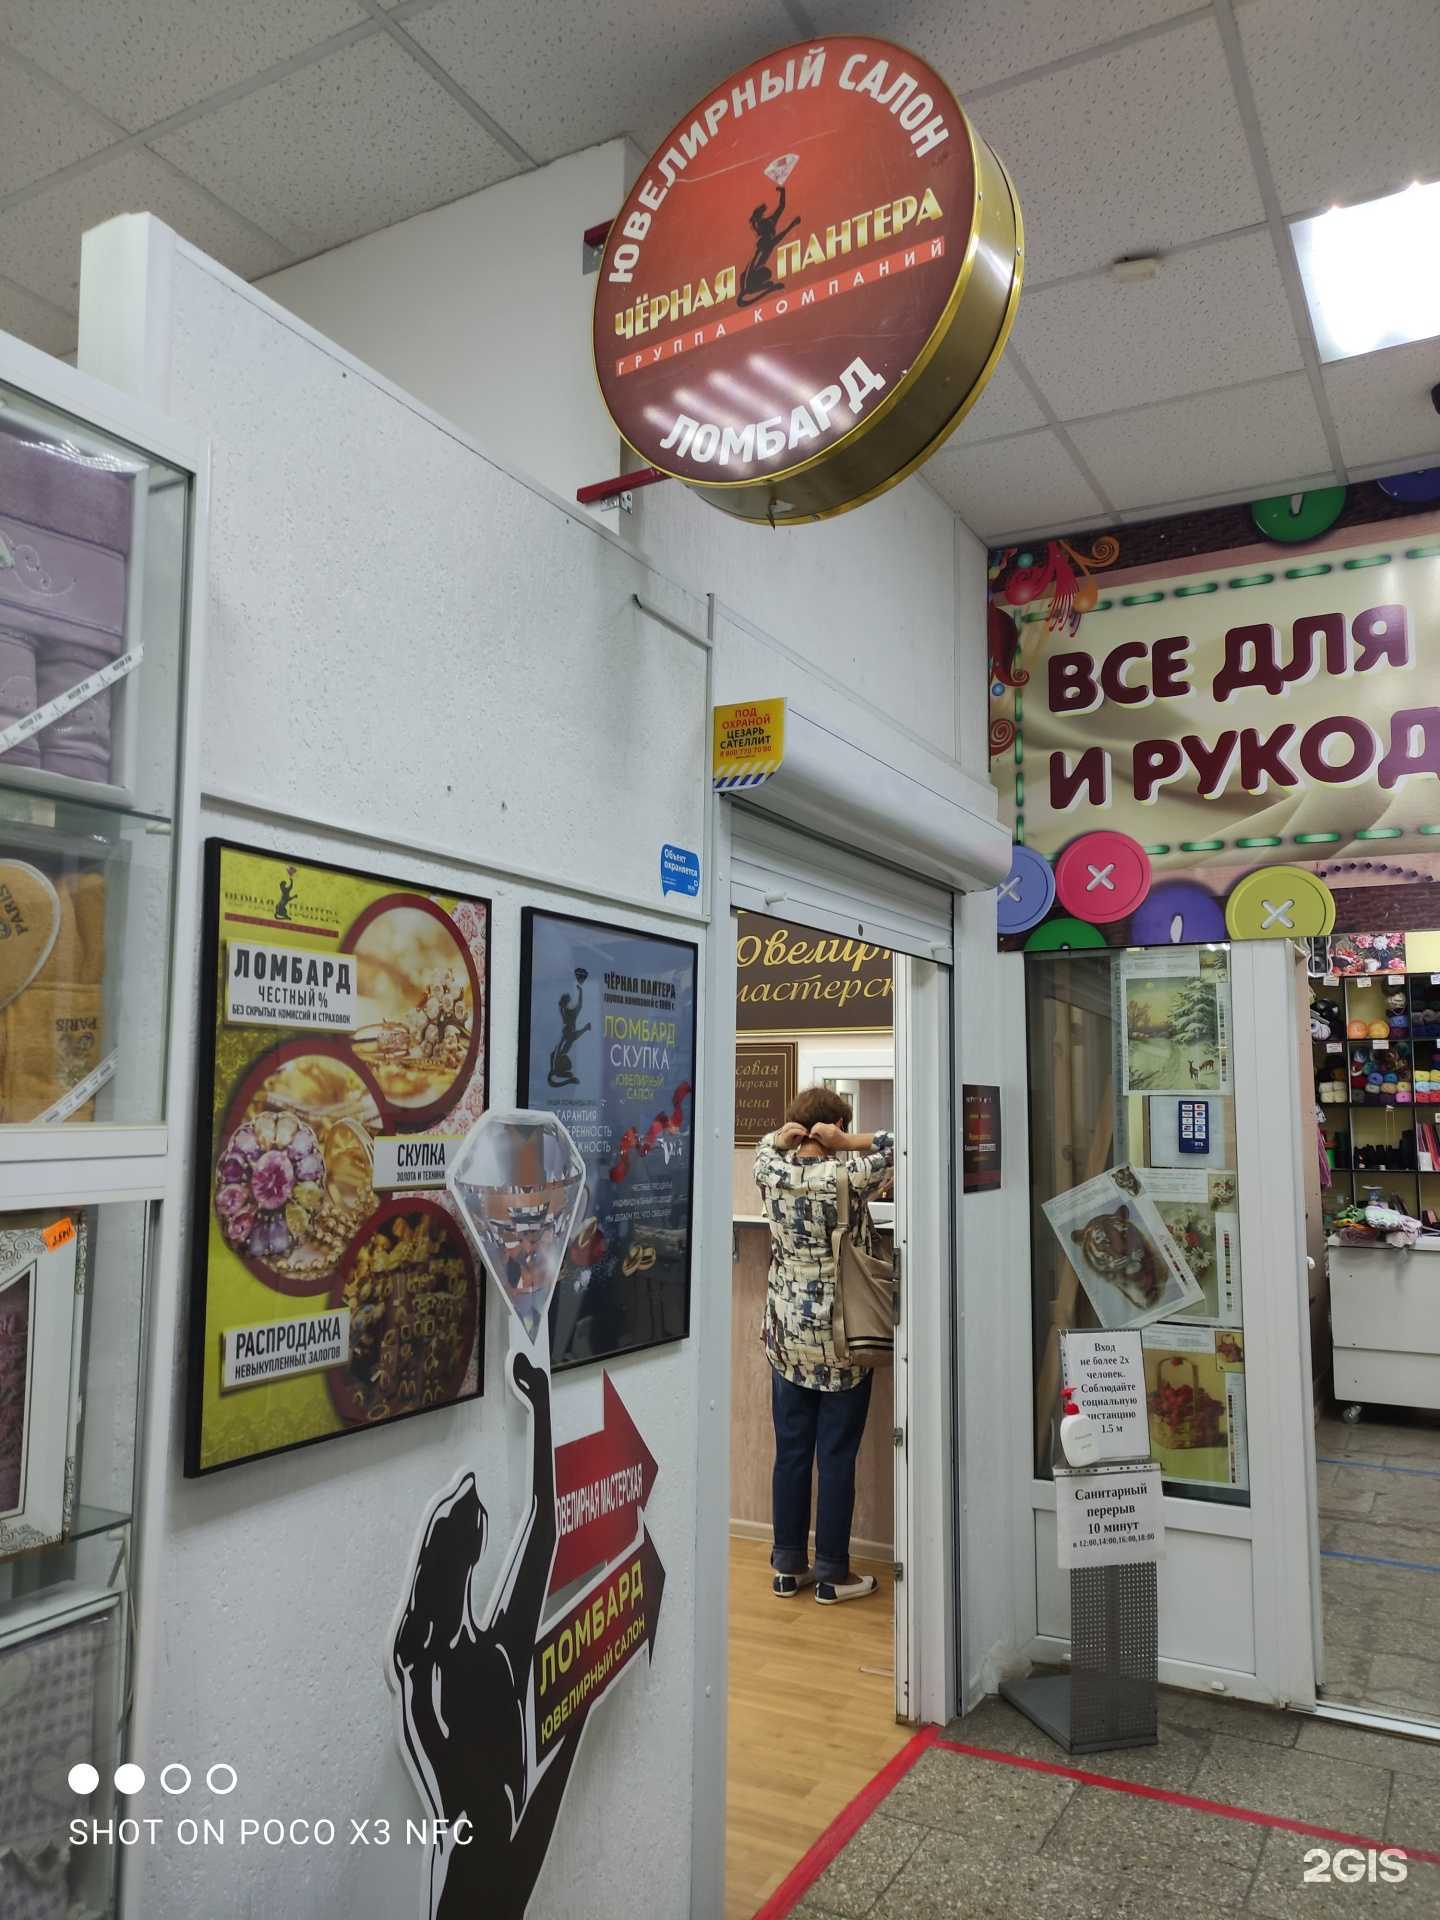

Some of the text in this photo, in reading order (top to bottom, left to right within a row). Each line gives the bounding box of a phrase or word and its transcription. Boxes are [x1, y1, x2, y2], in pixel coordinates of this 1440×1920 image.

[608, 46, 949, 284] ЮВЕЛИРНЫЙ САЛОН
[615, 188, 943, 341] ЧЁРНАЯ ПАНТЕРА
[618, 239, 944, 374] ГРУППА КОМПАНИЙ
[660, 356, 886, 466] ЛОМБАРД
[1048, 604, 1411, 715] ВСЕ ДЛЯ
[722, 713, 770, 730] ОХРАНОЙ
[735, 707, 757, 718] ПОД
[720, 735, 771, 750] САТЕЛЛИТ
[727, 726, 765, 740] ЦЕЗАРЬ
[1050, 706, 1440, 810] И РУКОД
[234, 948, 351, 995] ЛОМБАРД
[258, 985, 328, 1008] ЧЕСТНЫЙ %
[232, 1003, 245, 1015] БЕЗ
[246, 1005, 276, 1018] СКРЫТЫХ
[278, 1008, 311, 1021] КОМИССИЙ
[318, 1012, 351, 1024] СТРАХОВОК
[604, 1015, 676, 1048] ЛОМБАРД
[610, 1043, 670, 1071] СКУПКА
[556, 1110, 598, 1121] ГАРАНТИЯ
[567, 1125, 613, 1137] ЕРЕННОСТЬ
[397, 1142, 446, 1167] СКУПКА
[235, 1317, 341, 1360] РАСПРОДАЖА
[1094, 1343, 1117, 1353] Вход
[235, 1346, 341, 1379] НЕВЫКУПЛЕННЫХ ЗАЛОГОВ
[1093, 1356, 1118, 1365] более
[1081, 1382, 1136, 1393] Соблюдайте
[1081, 1398, 1138, 1408] социальную
[601, 1463, 643, 1516] МАСТЕРСКАЯ
[1075, 1482, 1148, 1501] Санитарный
[1087, 1504, 1136, 1519] перерыв
[1088, 1521, 1139, 1534] 10 минут
[540, 1560, 644, 1696] ЛОМБАРД
[541, 1613, 646, 1745] ЮВЕЛИРНЫЙ САЛОН
